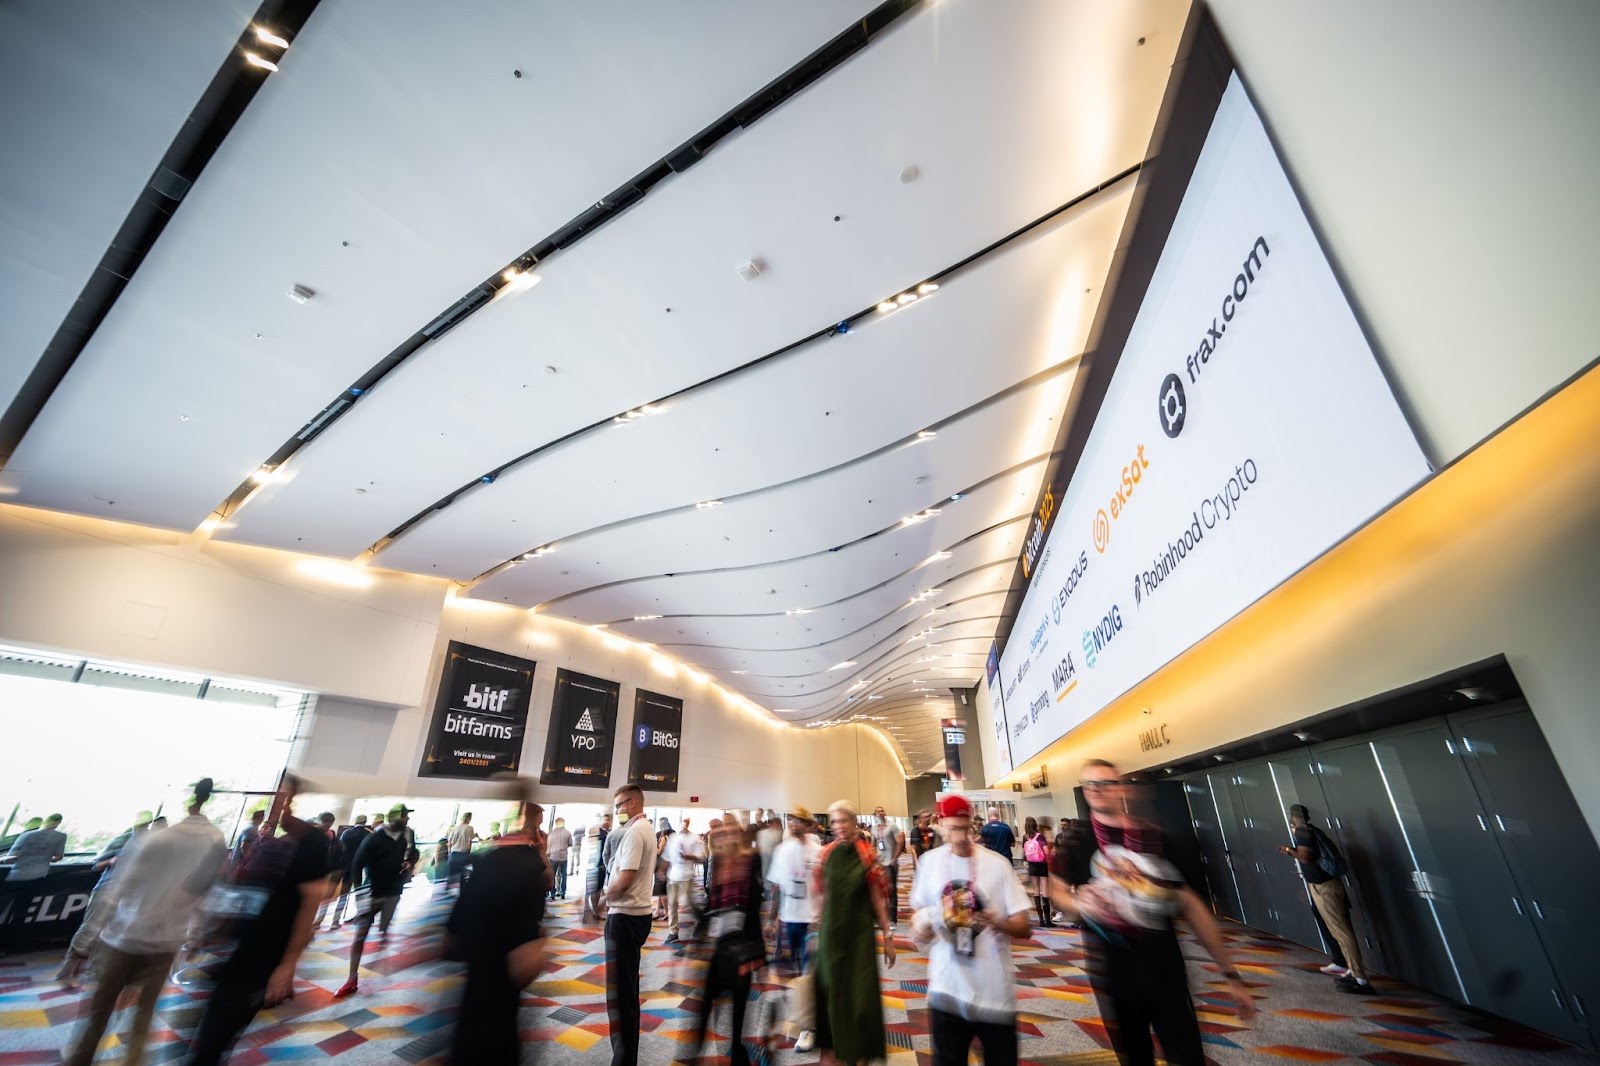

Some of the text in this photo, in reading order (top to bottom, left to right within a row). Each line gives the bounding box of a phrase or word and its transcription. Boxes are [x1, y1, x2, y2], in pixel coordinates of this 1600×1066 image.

[1186, 235, 1270, 384] frax.com
[1110, 443, 1149, 519] exSat
[1142, 458, 1258, 595] Robinhood Crypto
[1058, 550, 1089, 608] EXODUS
[1092, 604, 1123, 654] NYDIG
[1052, 652, 1076, 693] MARA
[463, 683, 509, 712] bitf
[444, 713, 513, 740] bitfarms
[570, 734, 596, 751] YPO
[652, 730, 679, 749] BitGo
[1138, 727, 1163, 753] HALL
[453, 749, 467, 757] Visit
